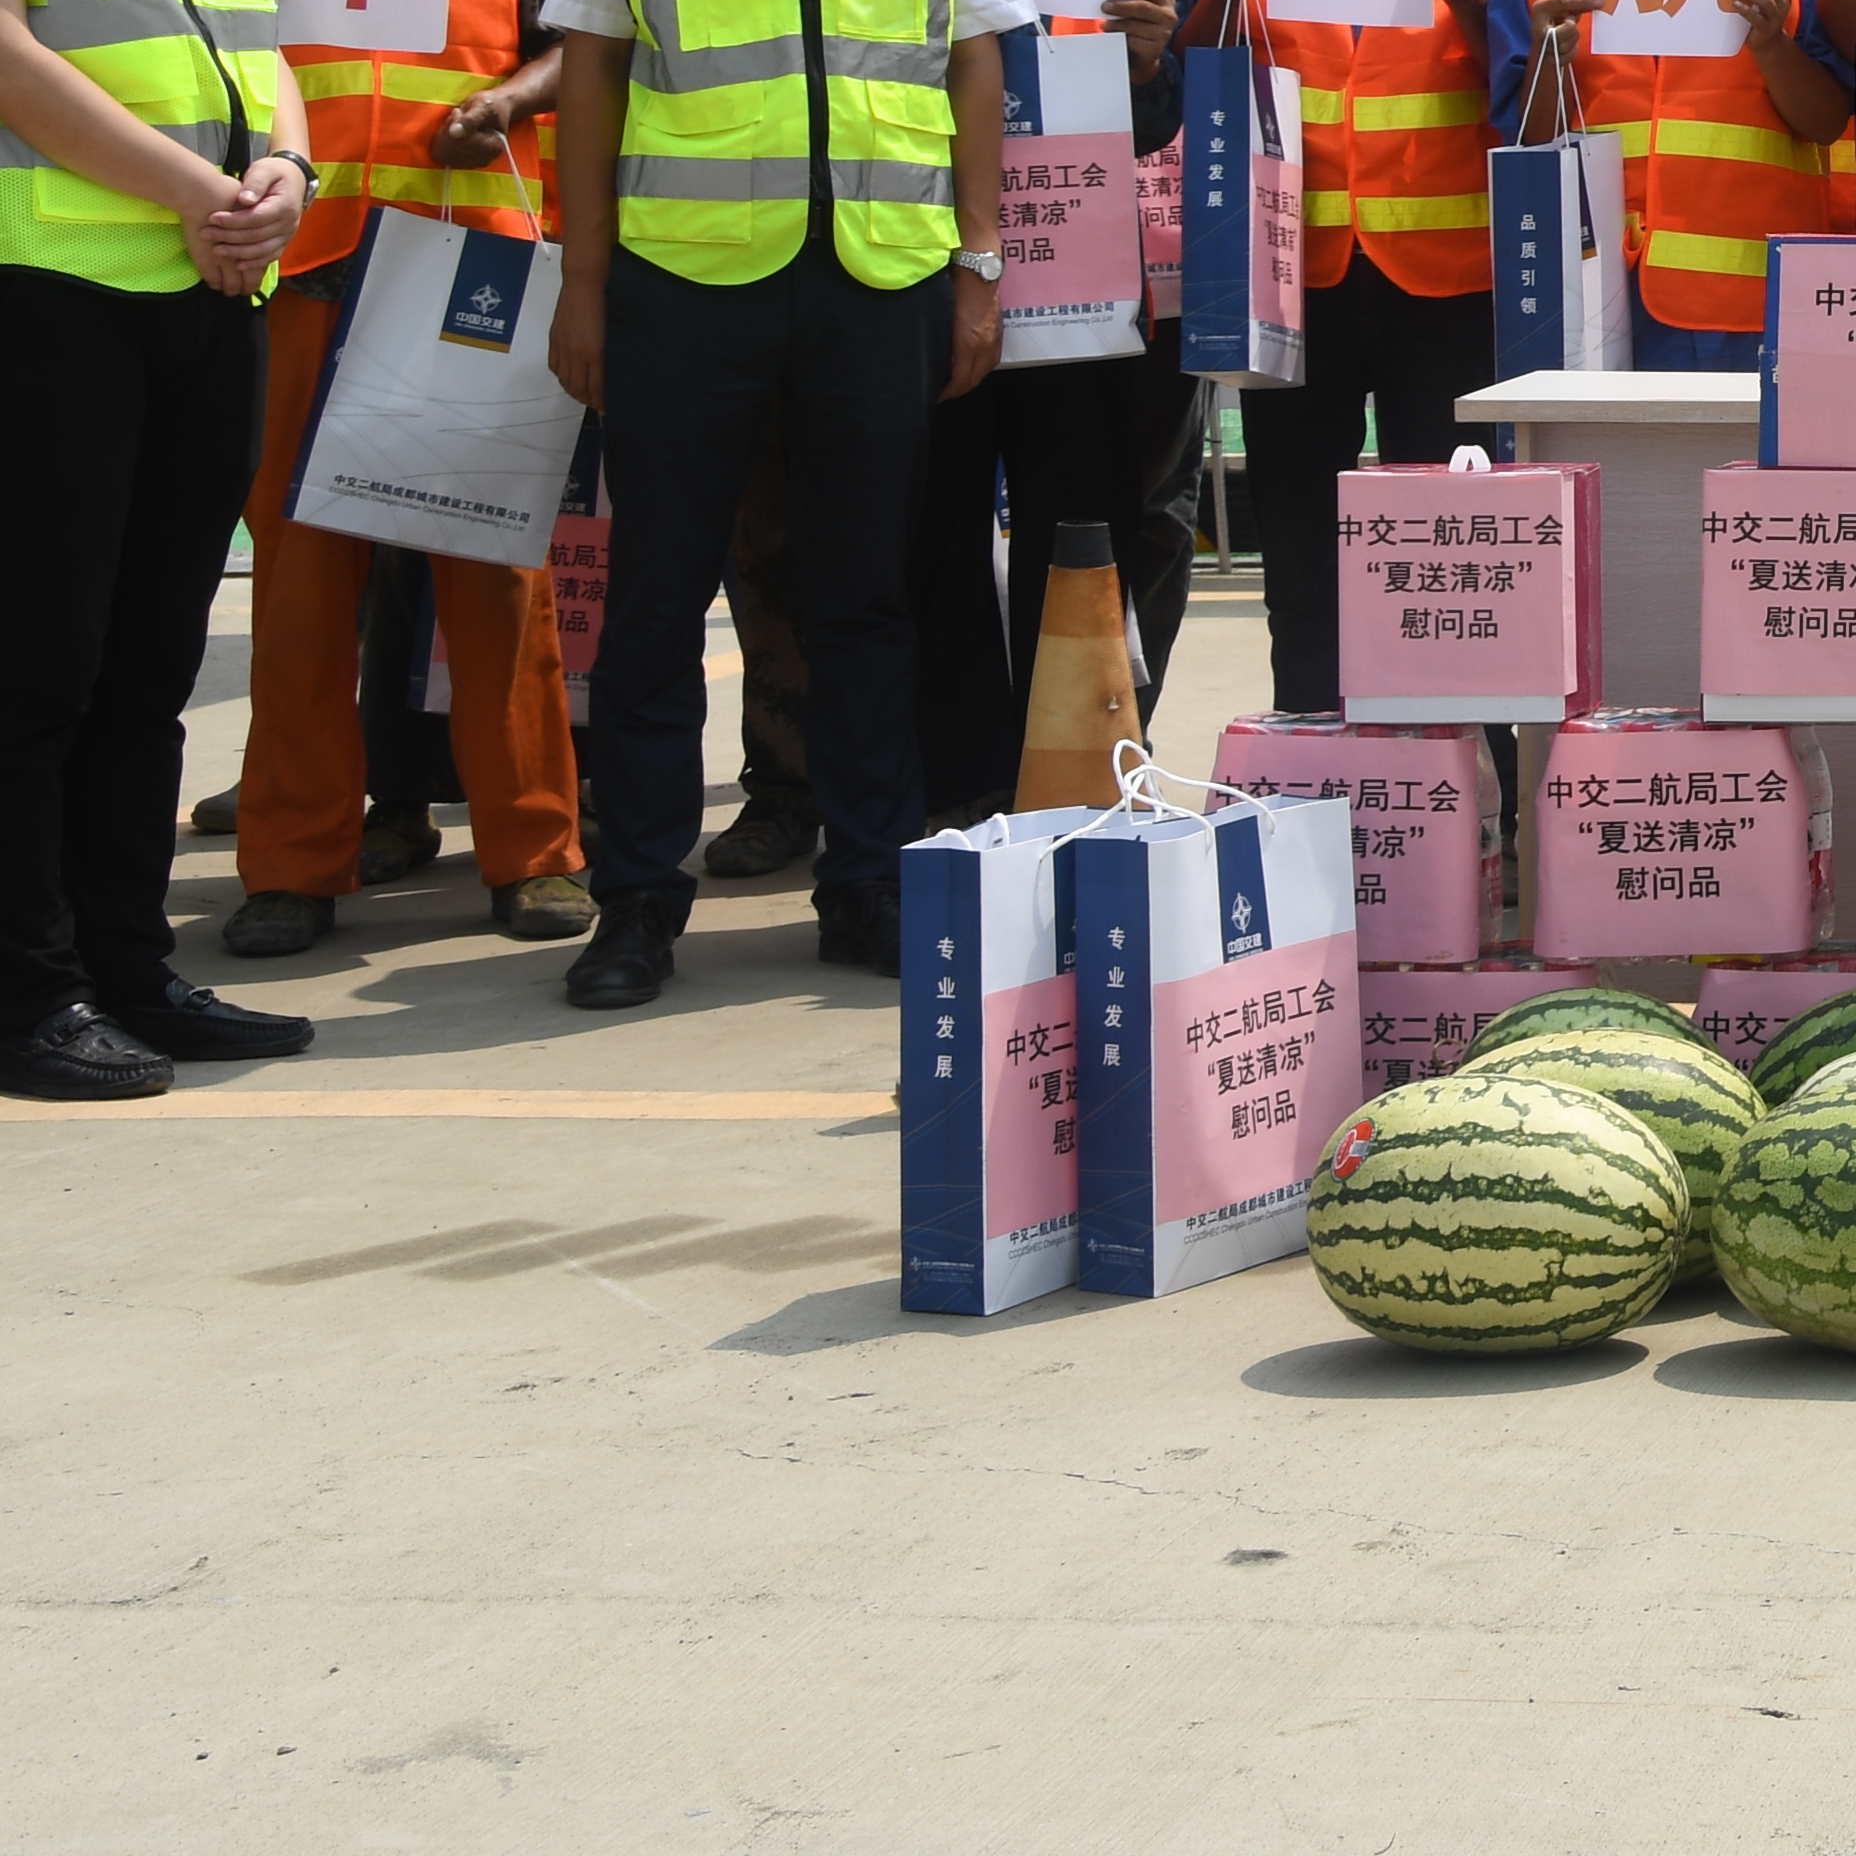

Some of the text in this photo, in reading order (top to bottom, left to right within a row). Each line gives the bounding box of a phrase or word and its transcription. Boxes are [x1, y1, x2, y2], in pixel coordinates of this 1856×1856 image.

[1207, 109, 1226, 208] 专业发展
[1520, 214, 1537, 314] 品质引领
[456, 311, 506, 330] 中国交建
[1338, 514, 1562, 547] 中交二航局工会
[1366, 560, 1533, 594] “夏送清凉”
[1400, 607, 1499, 640] 慰问品
[1547, 769, 1789, 809] 中交二航局工会
[1578, 816, 1755, 855] “夏送清凉”
[1615, 866, 1721, 901] 慰问品
[1227, 933, 1262, 955] 中国交建
[935, 936, 956, 1079] 专业发展
[1103, 927, 1126, 1068] 专业发展
[1186, 979, 1337, 1053] 中交二航局工会
[1207, 1031, 1316, 1094] “夏送清凉”
[1230, 1100, 1297, 1141] 慰问品
